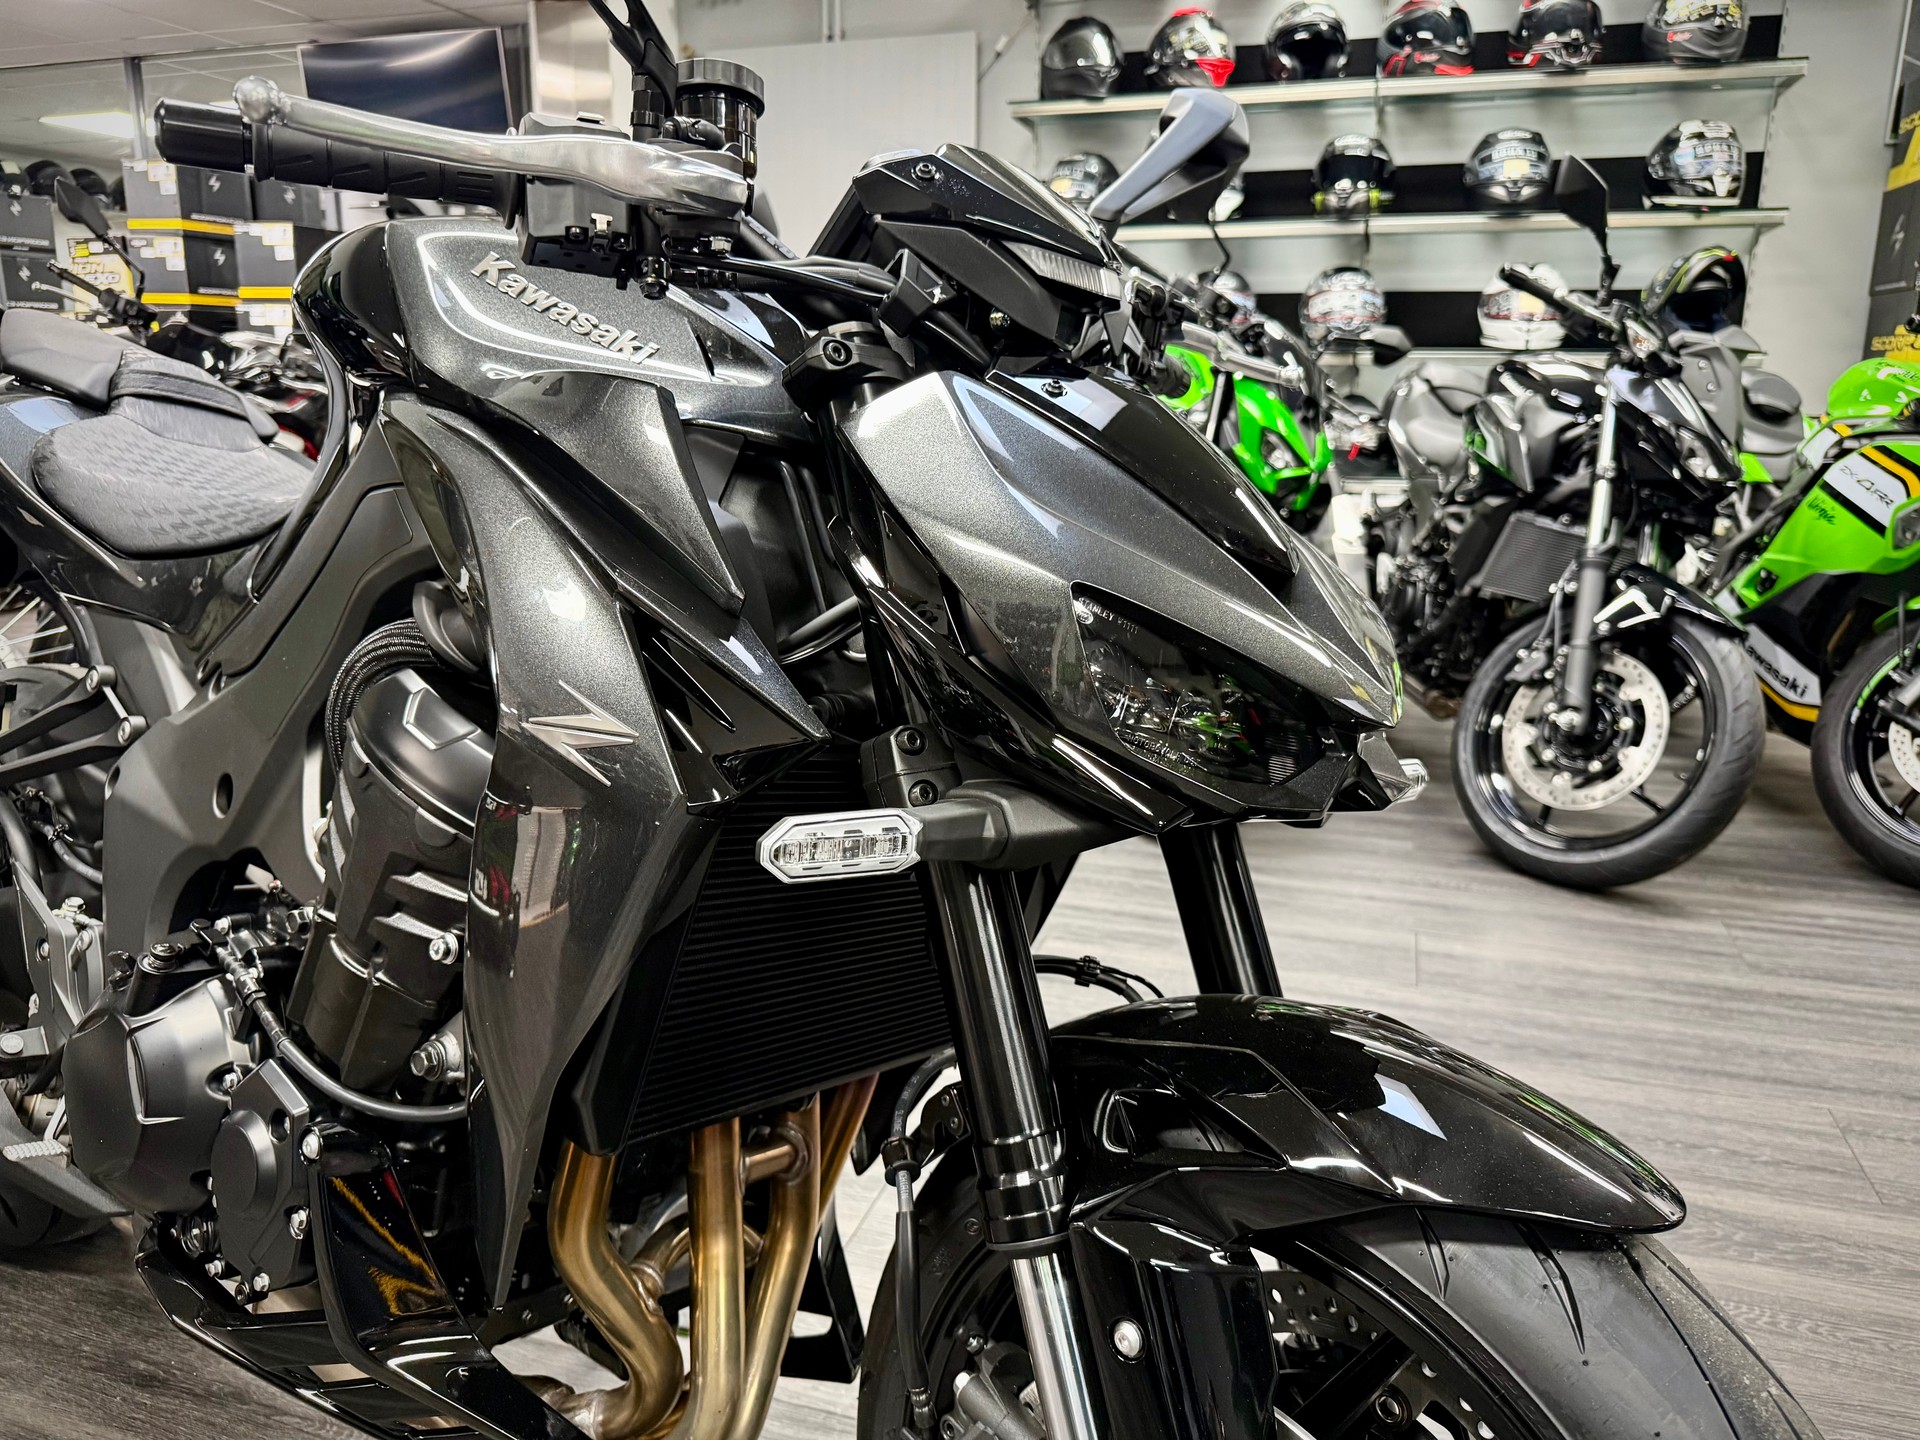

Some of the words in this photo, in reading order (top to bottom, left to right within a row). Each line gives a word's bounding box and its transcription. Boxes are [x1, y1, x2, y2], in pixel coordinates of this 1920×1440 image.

[470, 250, 661, 365] Kawasaki
[1078, 597, 1115, 622] STANLEY
[1745, 645, 1808, 699] awasaki
